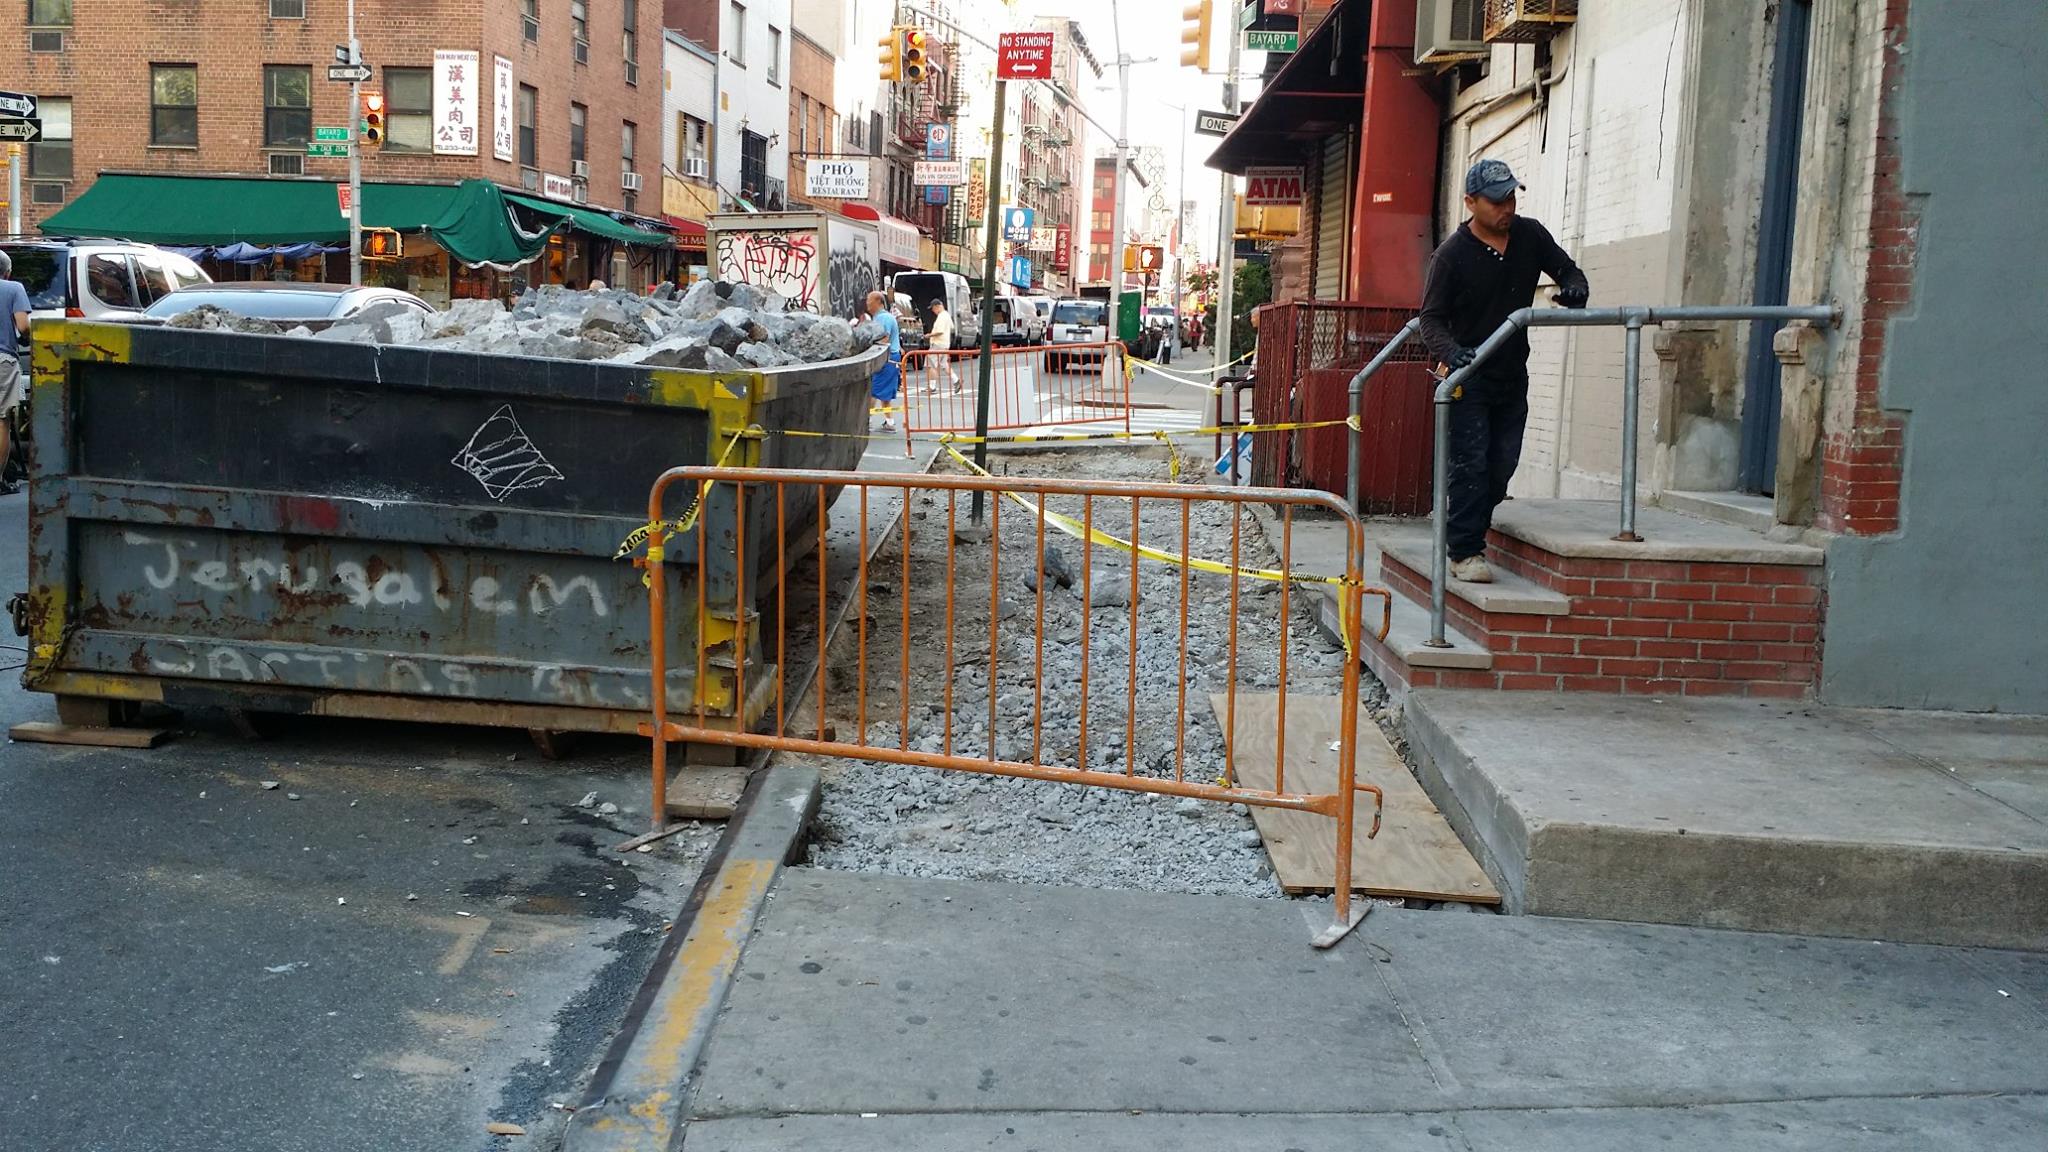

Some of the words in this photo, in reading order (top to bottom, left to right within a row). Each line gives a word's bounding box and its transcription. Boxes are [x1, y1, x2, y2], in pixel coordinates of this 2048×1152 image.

[1001, 36, 1012, 47] NO
[1015, 36, 1051, 47] STANDING
[1250, 33, 1286, 45] BAYARD
[1006, 49, 1045, 60] ANYTIME
[333, 69, 346, 77] ONE
[354, 69, 367, 77] WAY
[16, 100, 30, 111] WAY
[13, 125, 32, 136] WAY
[1206, 118, 1229, 132] ONE
[811, 186, 862, 196] RESTAURANT
[1246, 177, 1301, 199] ATM
[125, 531, 608, 617] Jerusalem
